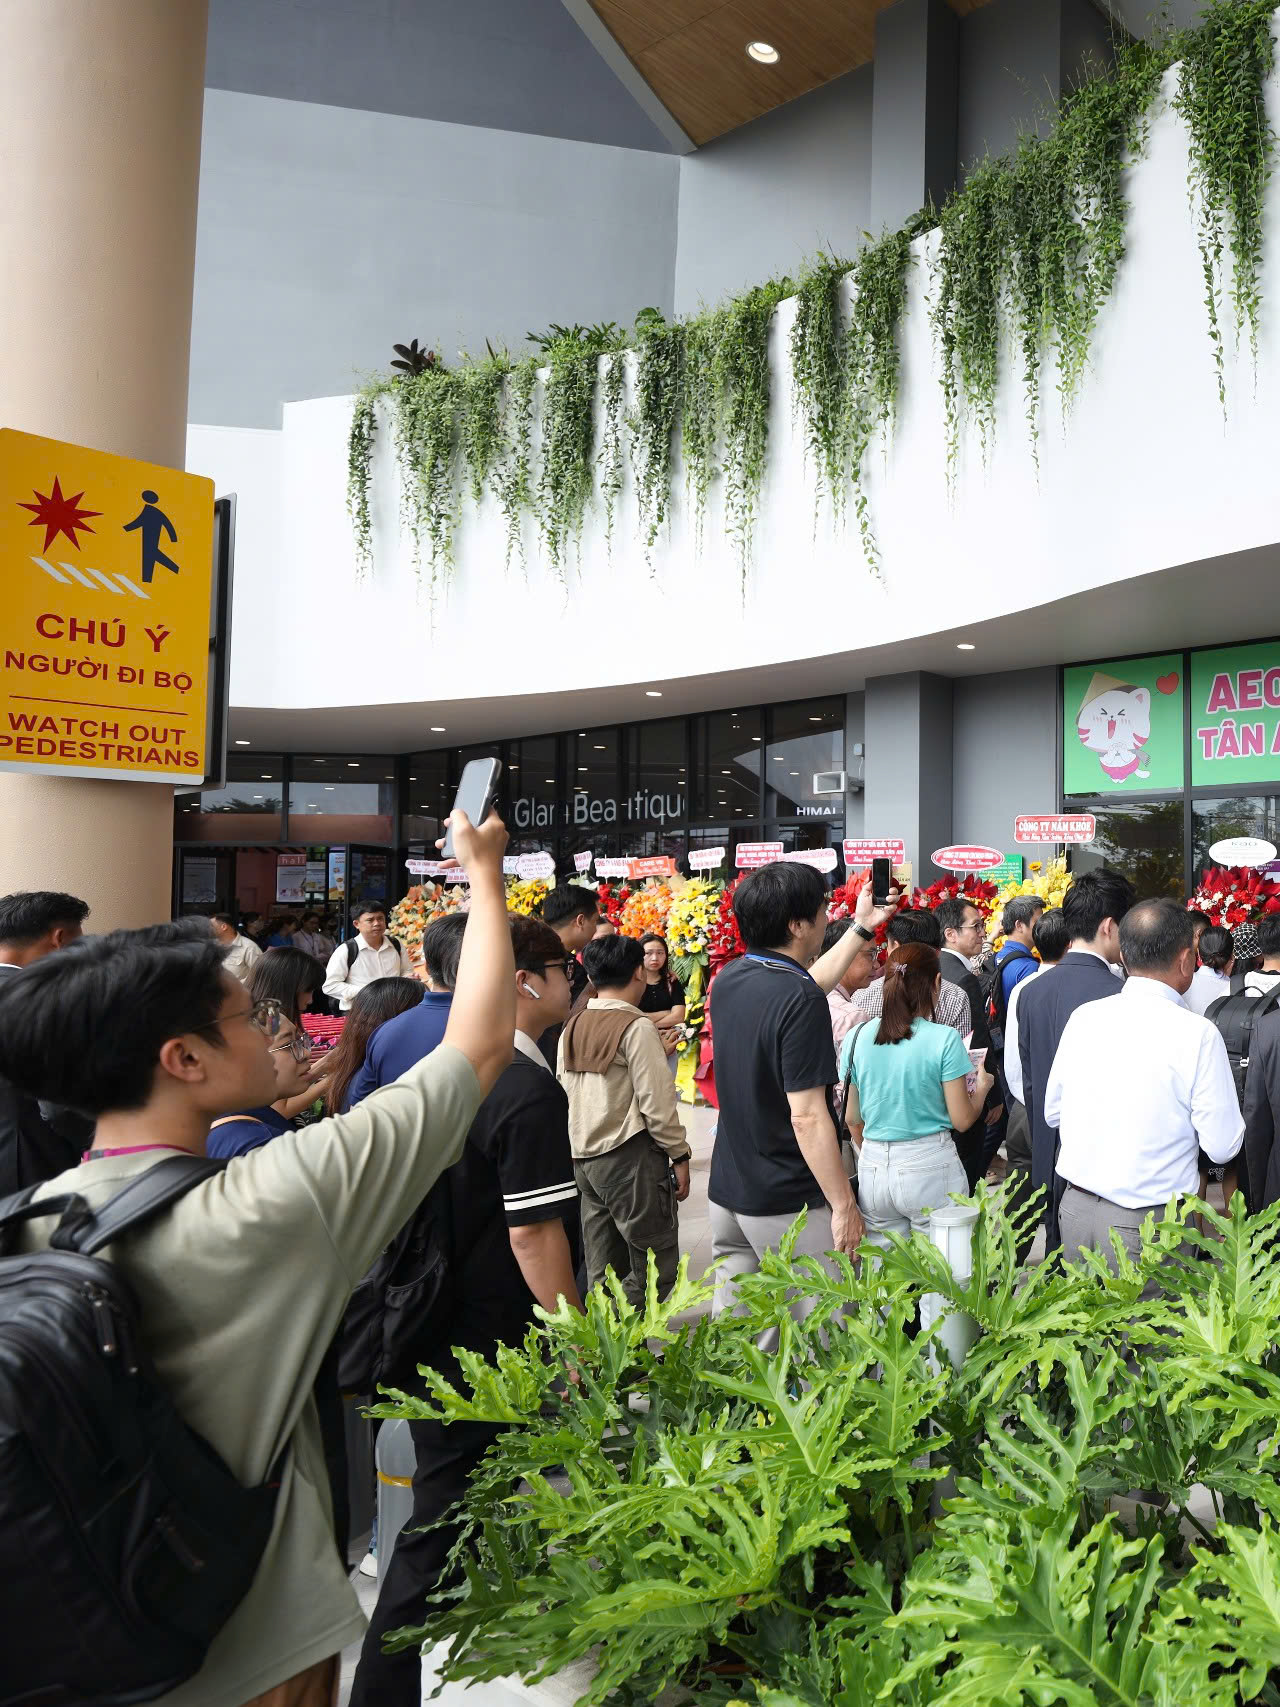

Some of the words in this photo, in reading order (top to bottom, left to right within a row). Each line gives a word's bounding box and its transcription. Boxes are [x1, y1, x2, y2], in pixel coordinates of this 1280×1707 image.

[35, 613, 127, 648] CHÚ
[144, 624, 171, 652] Ý
[4, 650, 109, 681] NGƯỜI
[117, 666, 145, 685] ĐI
[153, 671, 194, 695] BỘ
[8, 712, 120, 740] WATCH
[128, 724, 186, 746] OUT
[1198, 721, 1266, 760] TÂN
[574, 789, 685, 826] Beatiqu
